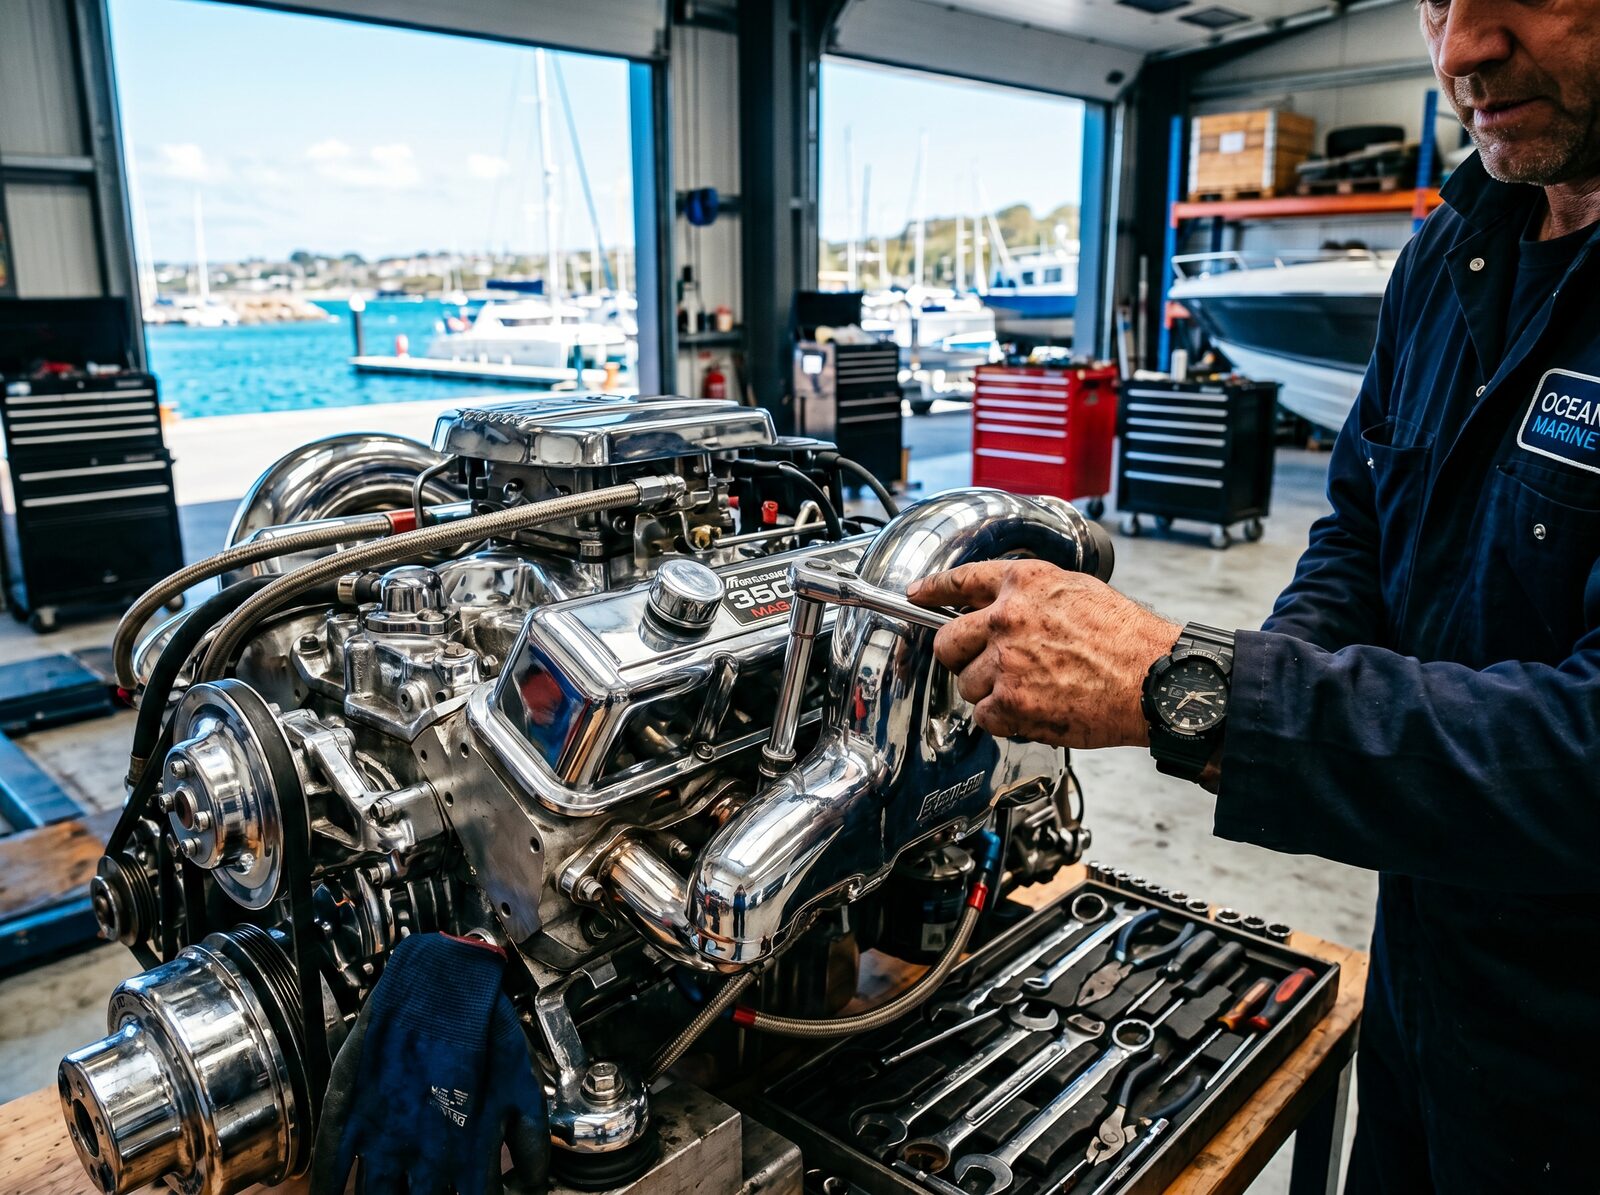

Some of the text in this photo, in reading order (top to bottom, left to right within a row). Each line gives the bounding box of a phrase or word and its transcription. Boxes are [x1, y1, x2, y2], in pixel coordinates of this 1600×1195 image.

[1531, 415, 1600, 451] MARINE
[727, 580, 795, 610] 350
[750, 600, 790, 618] MAG
